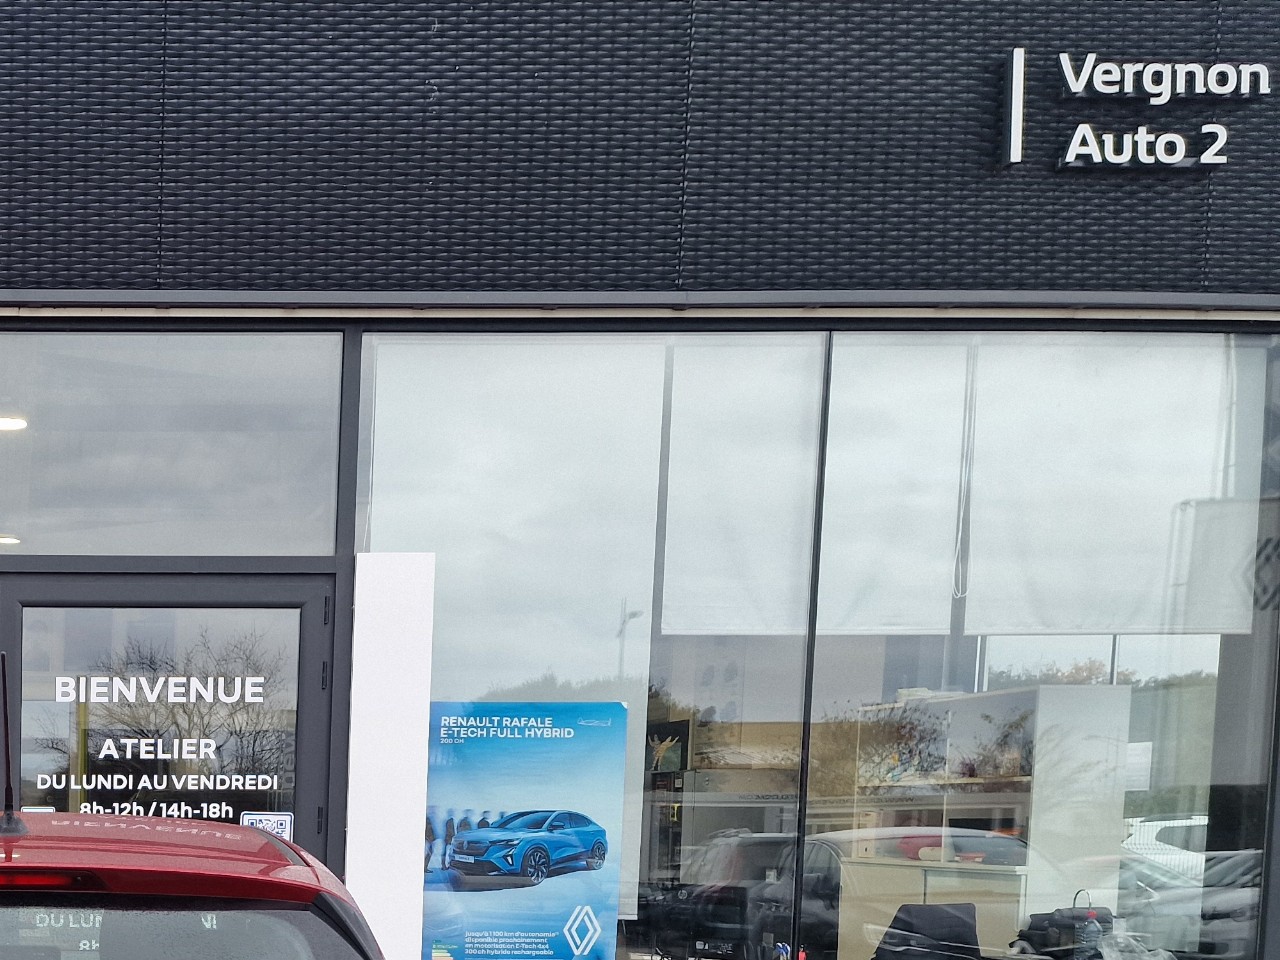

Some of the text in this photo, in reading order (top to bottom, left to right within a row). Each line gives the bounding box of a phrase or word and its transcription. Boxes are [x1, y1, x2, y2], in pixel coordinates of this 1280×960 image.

[1059, 52, 1271, 106] Vergnon
[1065, 123, 1228, 164] Auto 2
[55, 676, 265, 703] BIENVENUE
[441, 717, 553, 727] RENAULT RAFALE
[440, 728, 575, 738] E-TECH FULL HYBRID
[98, 738, 217, 760] ATELIER
[36, 774, 278, 791] DU LUNDI AU VENDREDI
[80, 802, 144, 818] 8h-12h
[160, 802, 233, 819] 14h-18h
